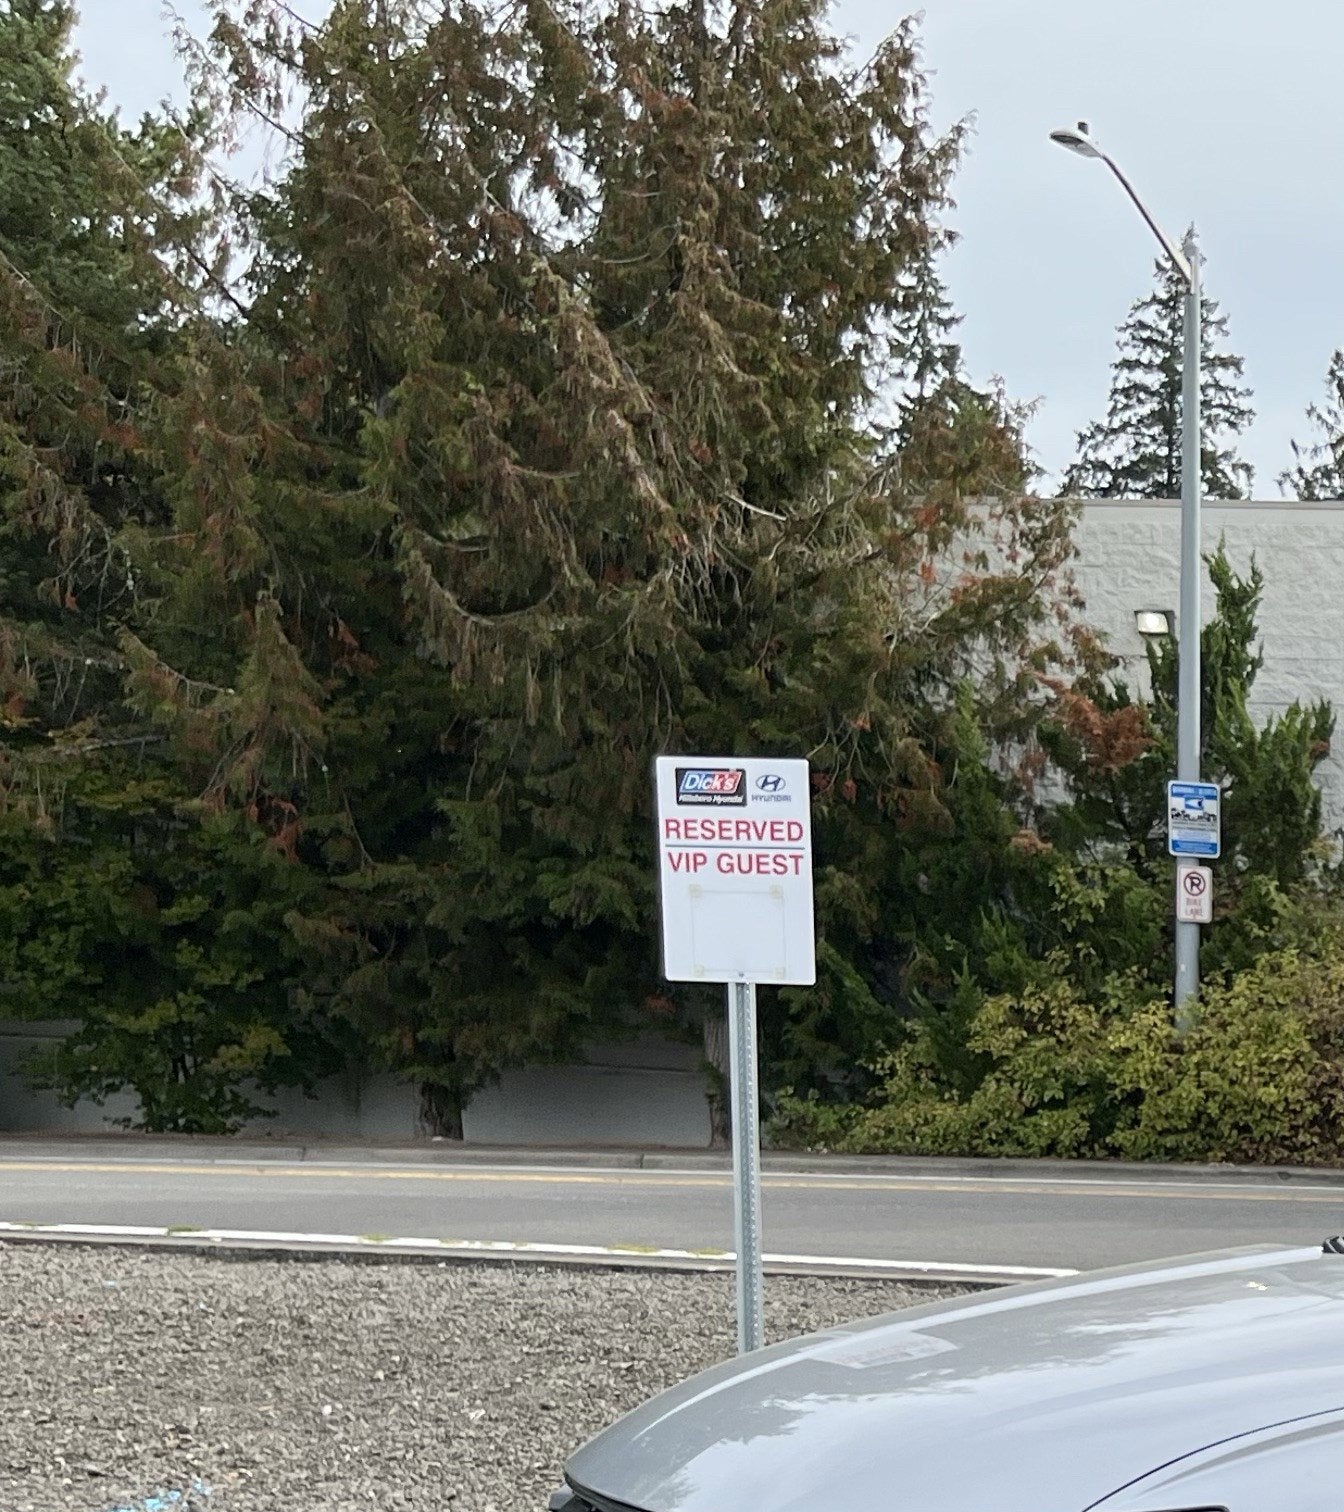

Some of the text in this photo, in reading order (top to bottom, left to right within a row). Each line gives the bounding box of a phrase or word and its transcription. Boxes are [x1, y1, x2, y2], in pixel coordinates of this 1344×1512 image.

[751, 794, 792, 802] HYUNDAI
[665, 819, 804, 841] RESERVED
[667, 852, 805, 875] VIP GUEST
